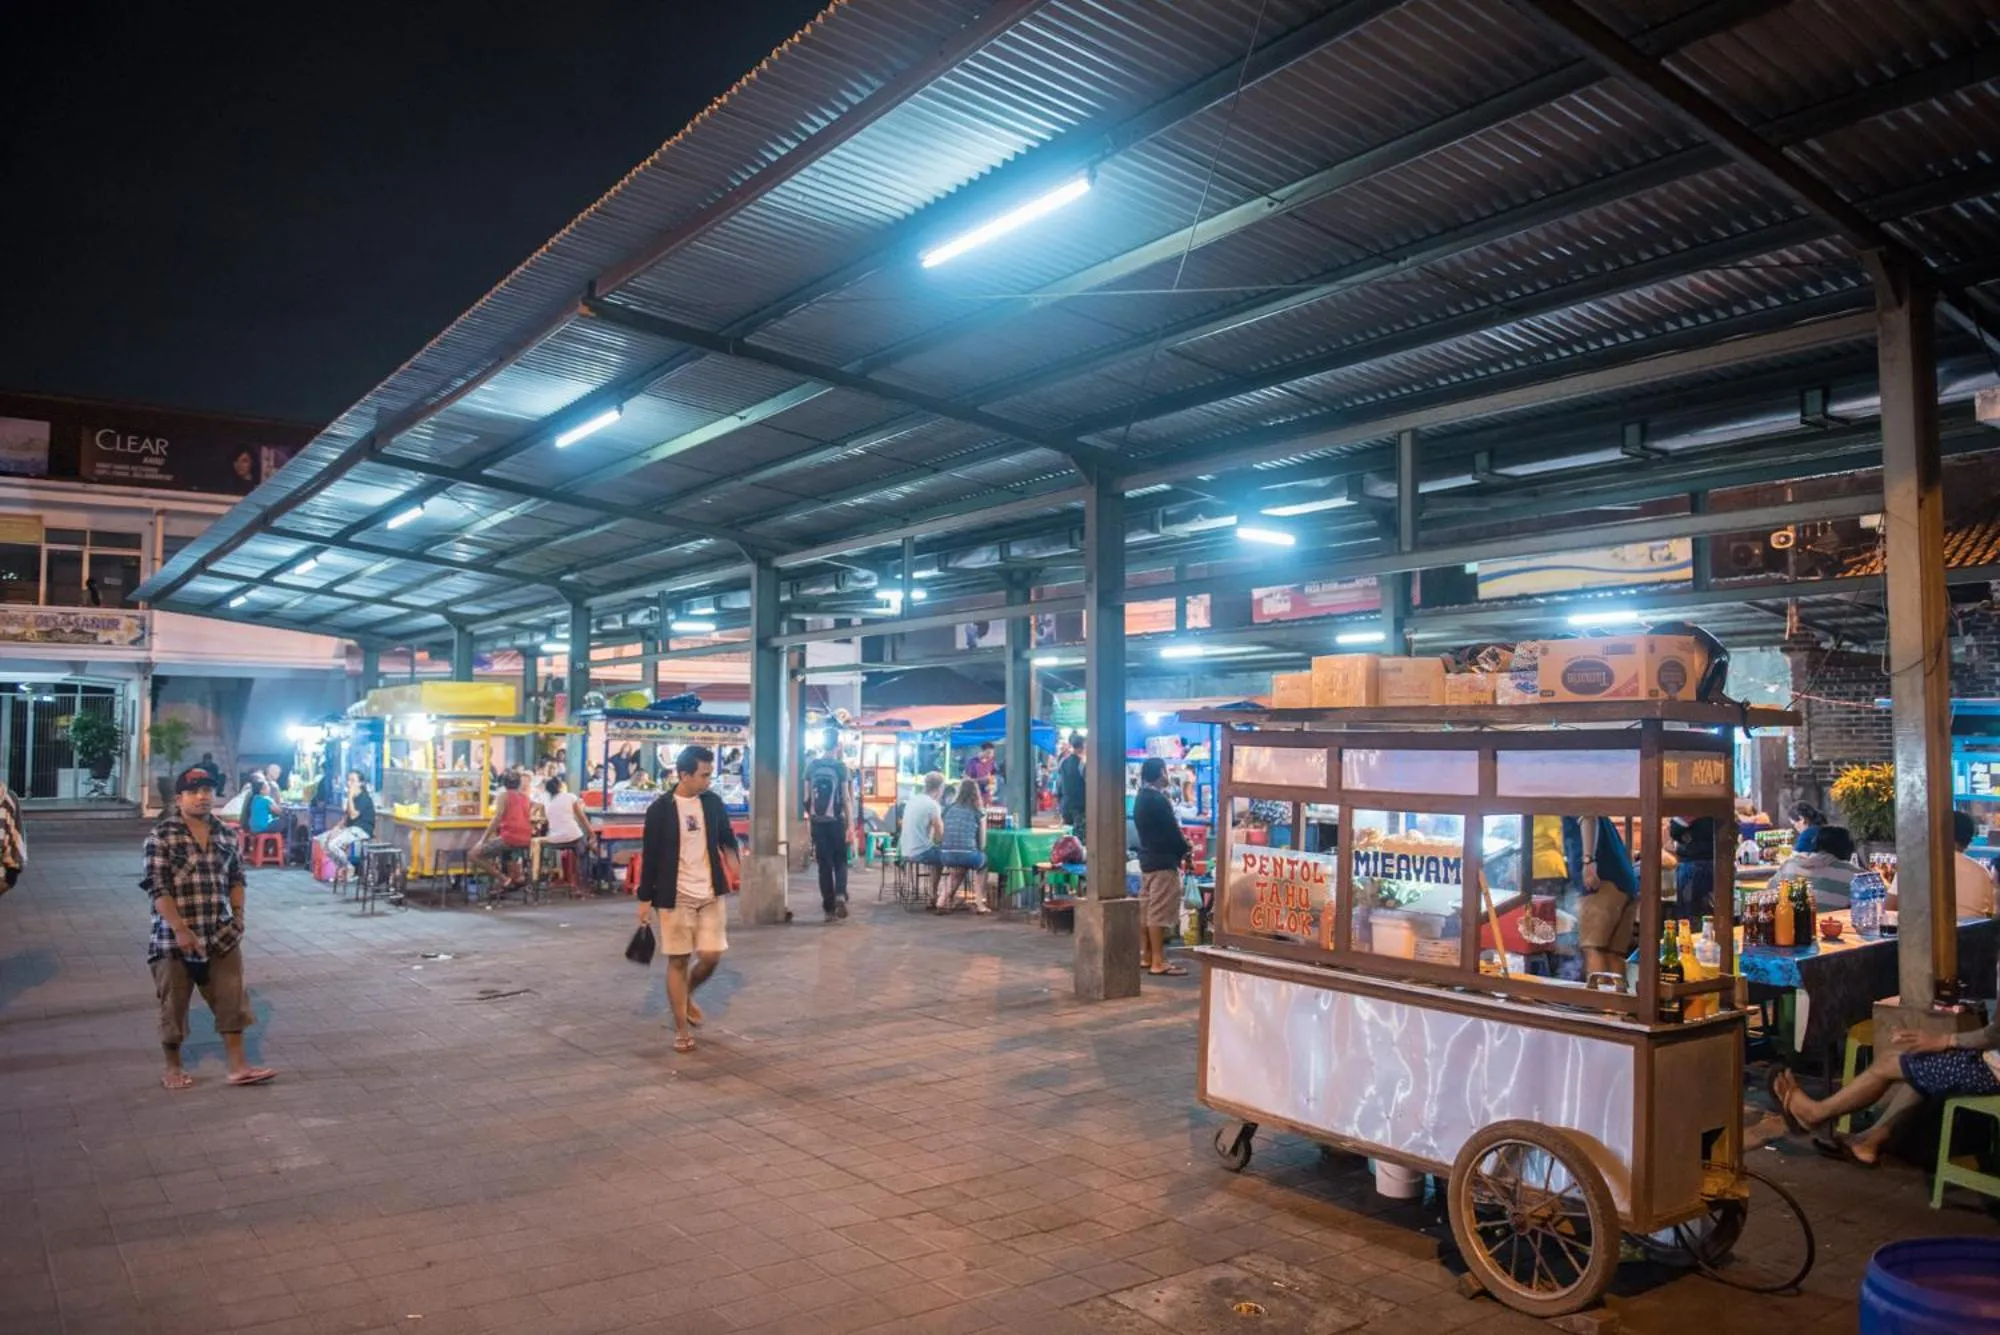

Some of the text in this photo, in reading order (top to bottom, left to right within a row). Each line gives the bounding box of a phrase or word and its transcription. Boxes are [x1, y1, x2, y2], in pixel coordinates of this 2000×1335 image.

[95, 428, 169, 456] CLEAR
[615, 720, 672, 731] GADO
[688, 723, 742, 734] GADO
[1241, 852, 1326, 884] PENTOL
[1354, 850, 1462, 885] MIEAYAM
[1256, 881, 1311, 911] TAHU
[1250, 906, 1314, 937] CILOK
